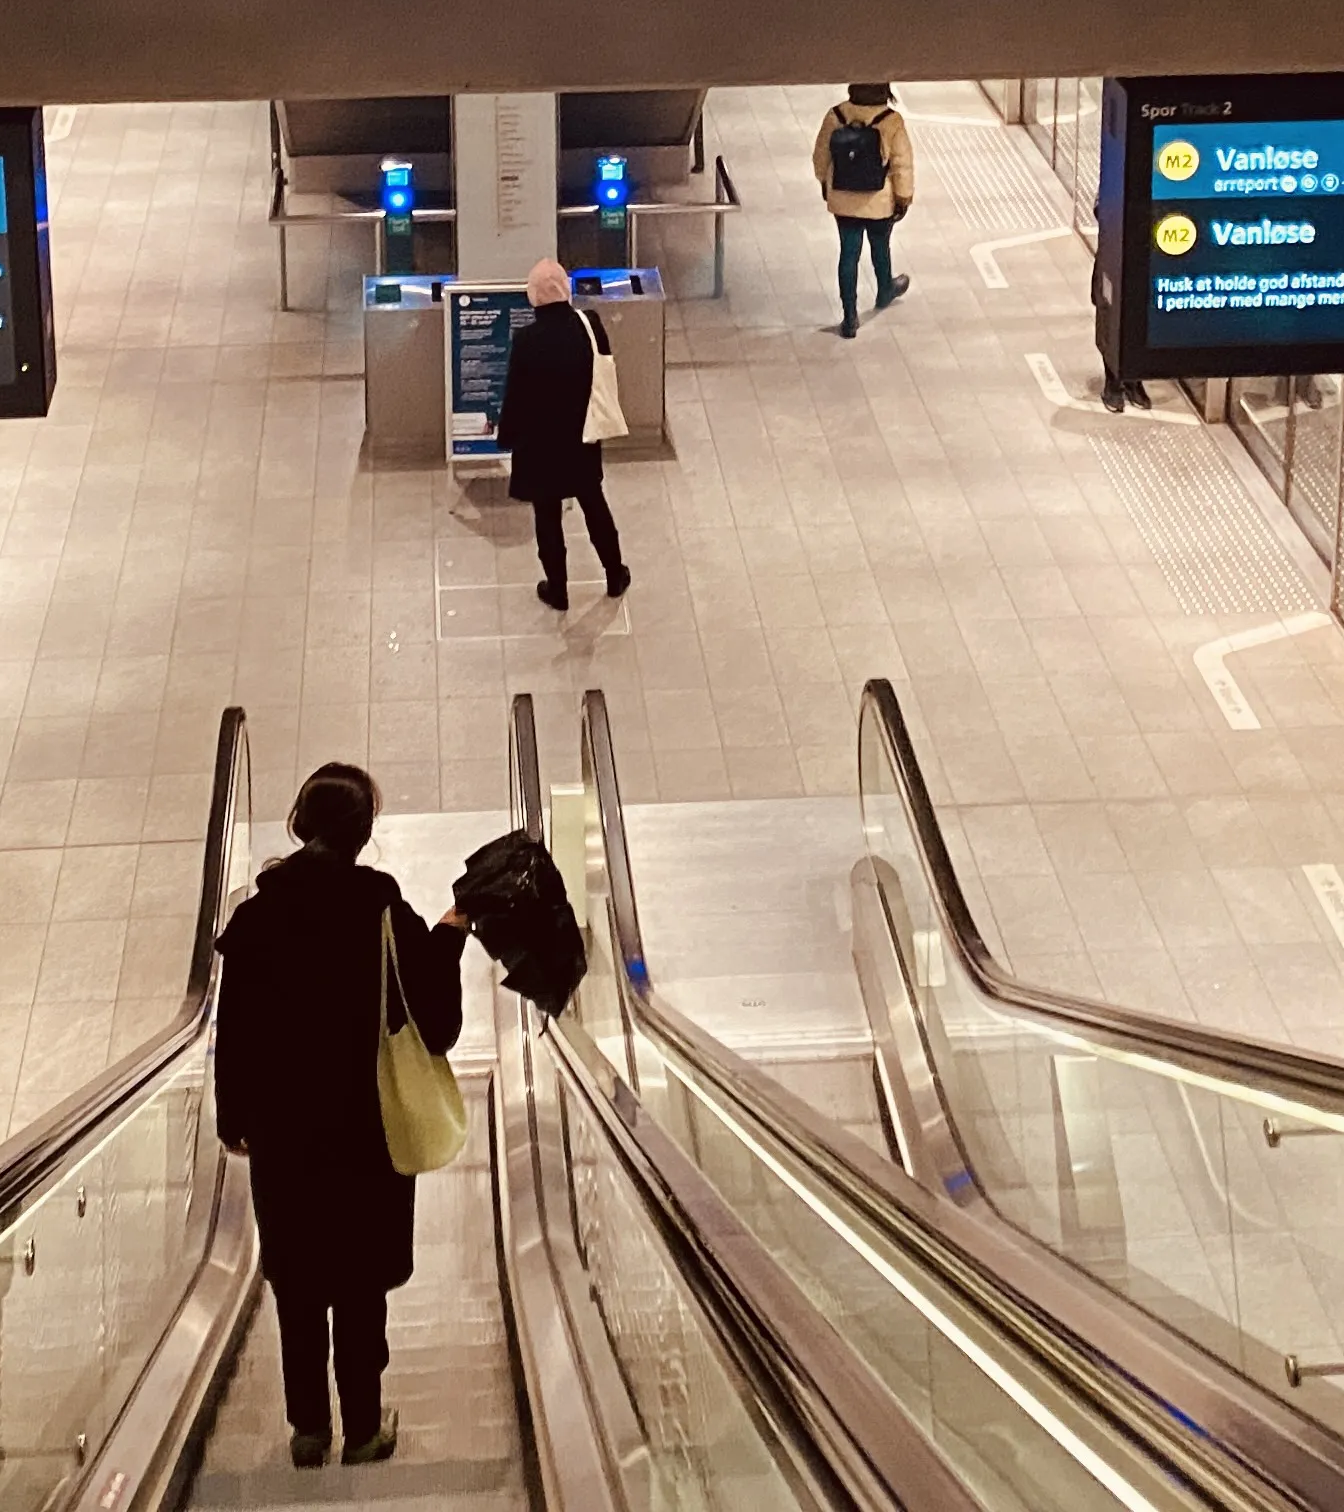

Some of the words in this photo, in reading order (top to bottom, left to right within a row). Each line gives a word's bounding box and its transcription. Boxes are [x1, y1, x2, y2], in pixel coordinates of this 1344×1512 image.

[1141, 104, 1177, 119] Spor
[1222, 102, 1232, 115] 2
[1166, 155, 1192, 168] M2
[1216, 147, 1319, 171] Vanløse
[1163, 229, 1190, 242] M2
[1212, 220, 1316, 246] Vanløse
[1157, 277, 1193, 292] Husk
[1196, 278, 1213, 291] at
[1215, 275, 1256, 291] holde
[1259, 274, 1289, 292] god
[1166, 293, 1228, 312] perioder
[1229, 292, 1263, 307] med
[1265, 291, 1316, 309] mange
